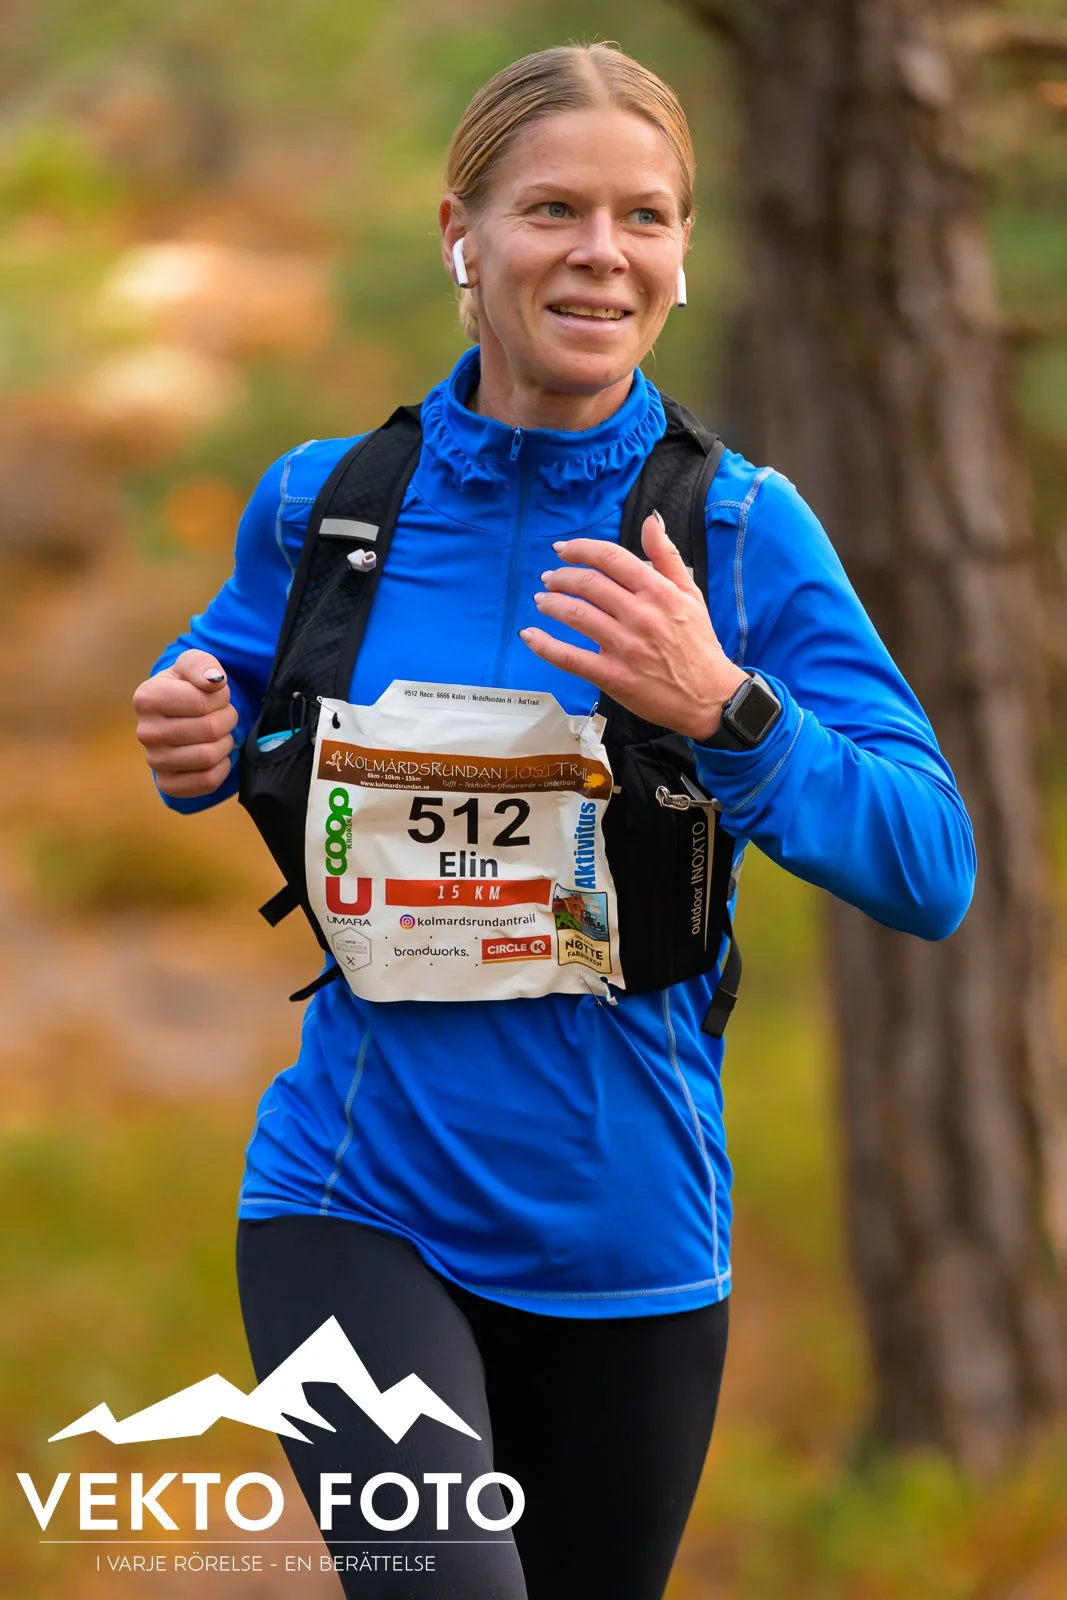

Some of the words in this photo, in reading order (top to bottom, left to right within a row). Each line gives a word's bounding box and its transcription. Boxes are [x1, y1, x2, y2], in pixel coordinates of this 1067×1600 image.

[419, 690, 434, 698] Race:
[384, 772, 401, 781] 10km
[360, 780, 430, 790] www.kolmardsrundan.se
[442, 780, 457, 788] Tufft
[407, 796, 531, 847] 512
[325, 787, 353, 876] coop
[574, 802, 597, 889] Aktivitus
[691, 820, 706, 886] INOXTO
[439, 850, 498, 877] Elin
[437, 885, 460, 900] 15
[474, 885, 501, 900] KM
[691, 886, 704, 936] outdoor
[326, 915, 372, 927] UMARA
[417, 913, 536, 927] kolmardsrundantrail
[487, 943, 527, 955] CIRCLE
